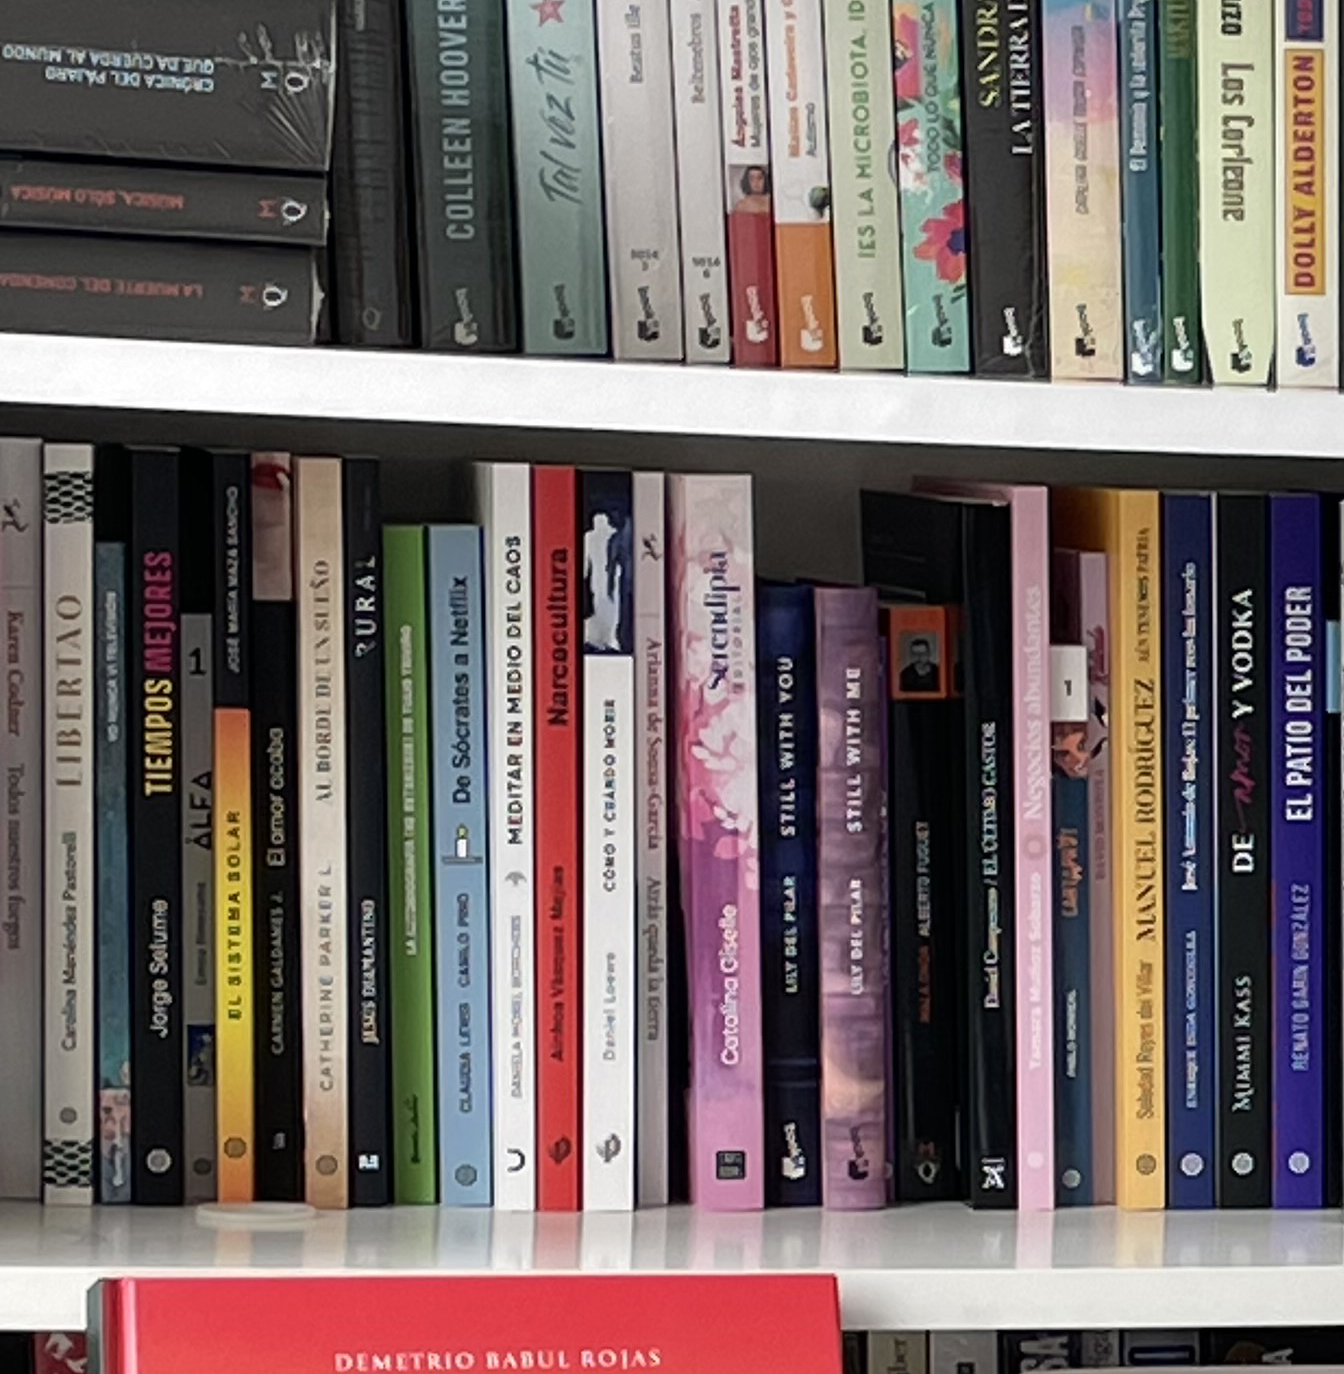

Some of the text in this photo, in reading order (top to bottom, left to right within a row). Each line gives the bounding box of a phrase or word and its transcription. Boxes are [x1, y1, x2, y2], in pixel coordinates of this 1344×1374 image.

[438, 0, 476, 240] COLLEEN HOOVER
[922, 3, 941, 173] TODO LO QUE NUNCA
[1220, 62, 1254, 222] Los Corleone
[1291, 54, 1316, 289] DOLLY ALDERTON
[144, 549, 174, 796] TIEMPOS MEJORES
[447, 576, 473, 804] De Sócrates a Netflix
[503, 534, 524, 846] MEDITAR EN MEDIO DEL CAOS
[546, 546, 570, 728] Narcocultura
[1231, 588, 1255, 873] DE Y VODKA
[1285, 586, 1314, 821] EL PATIO DEL PODER
[226, 809, 243, 1020] EL SISTEMA SOLAR
[1131, 677, 1158, 943] MANUEL RODRÍGUEZ
[149, 900, 173, 1040] Jorge Selume
[719, 904, 739, 1066] Catalina Giselle
[333, 1346, 662, 1374] DEMETRIO BABUL ROJAS
